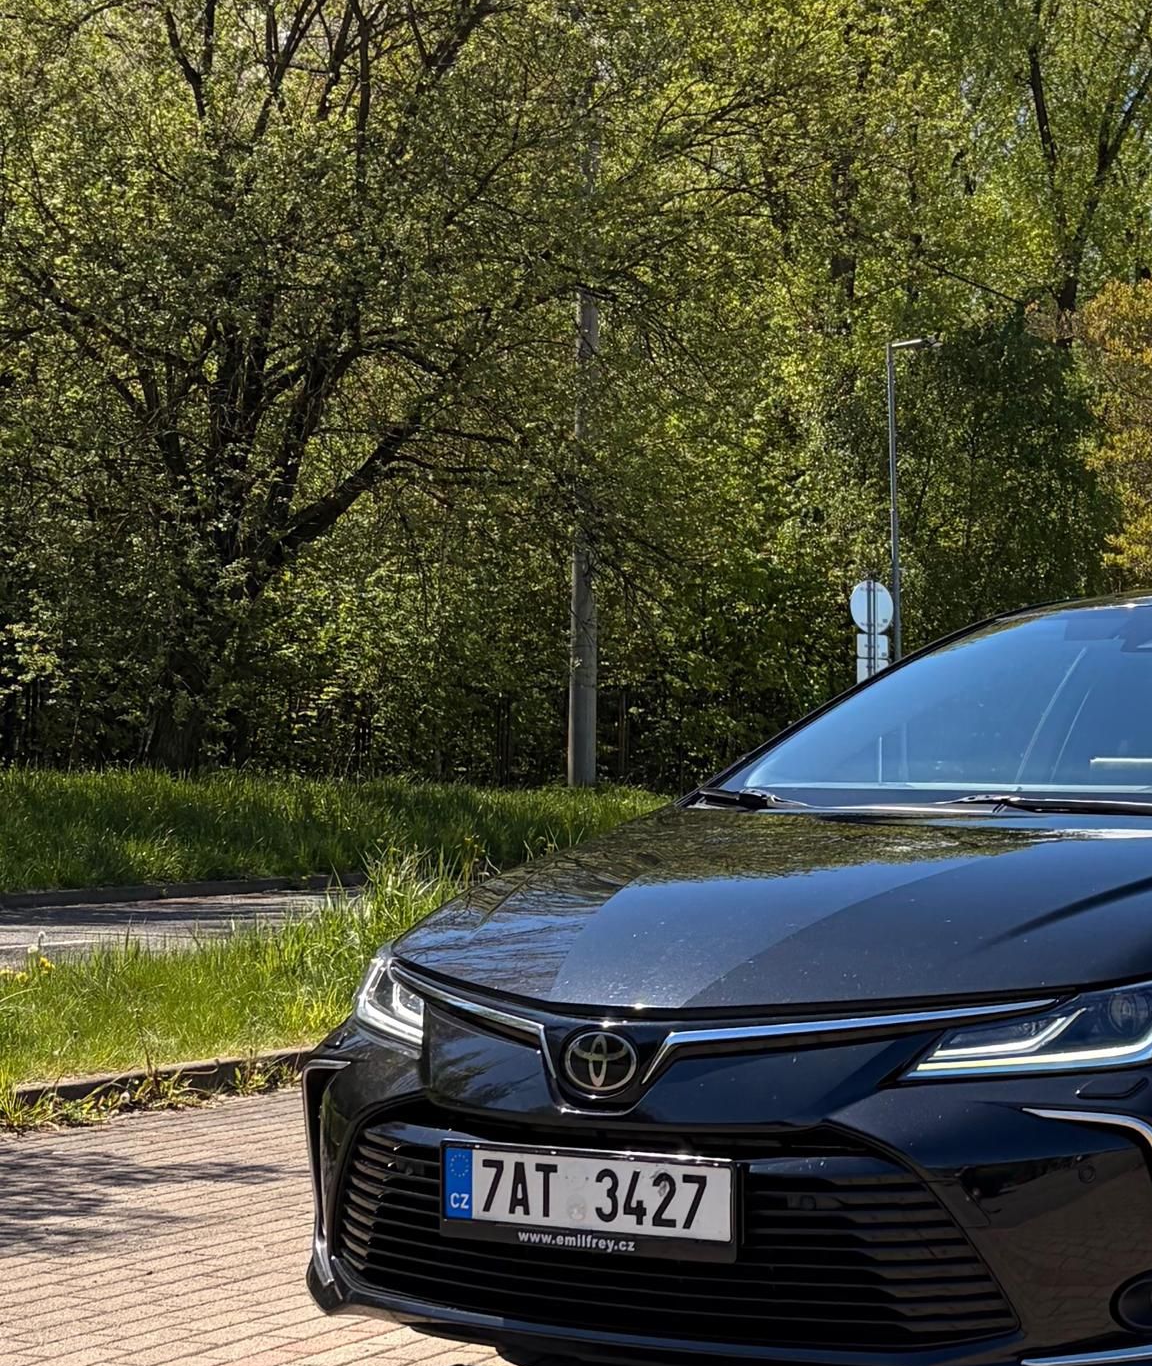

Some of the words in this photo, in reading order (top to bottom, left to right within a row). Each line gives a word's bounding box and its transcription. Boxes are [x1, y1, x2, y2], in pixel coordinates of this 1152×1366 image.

[450, 1192, 470, 1210] CZ
[482, 1159, 558, 1218] 7AT
[595, 1168, 707, 1229] 3427
[518, 1231, 635, 1253] www.emilfrey.cz
